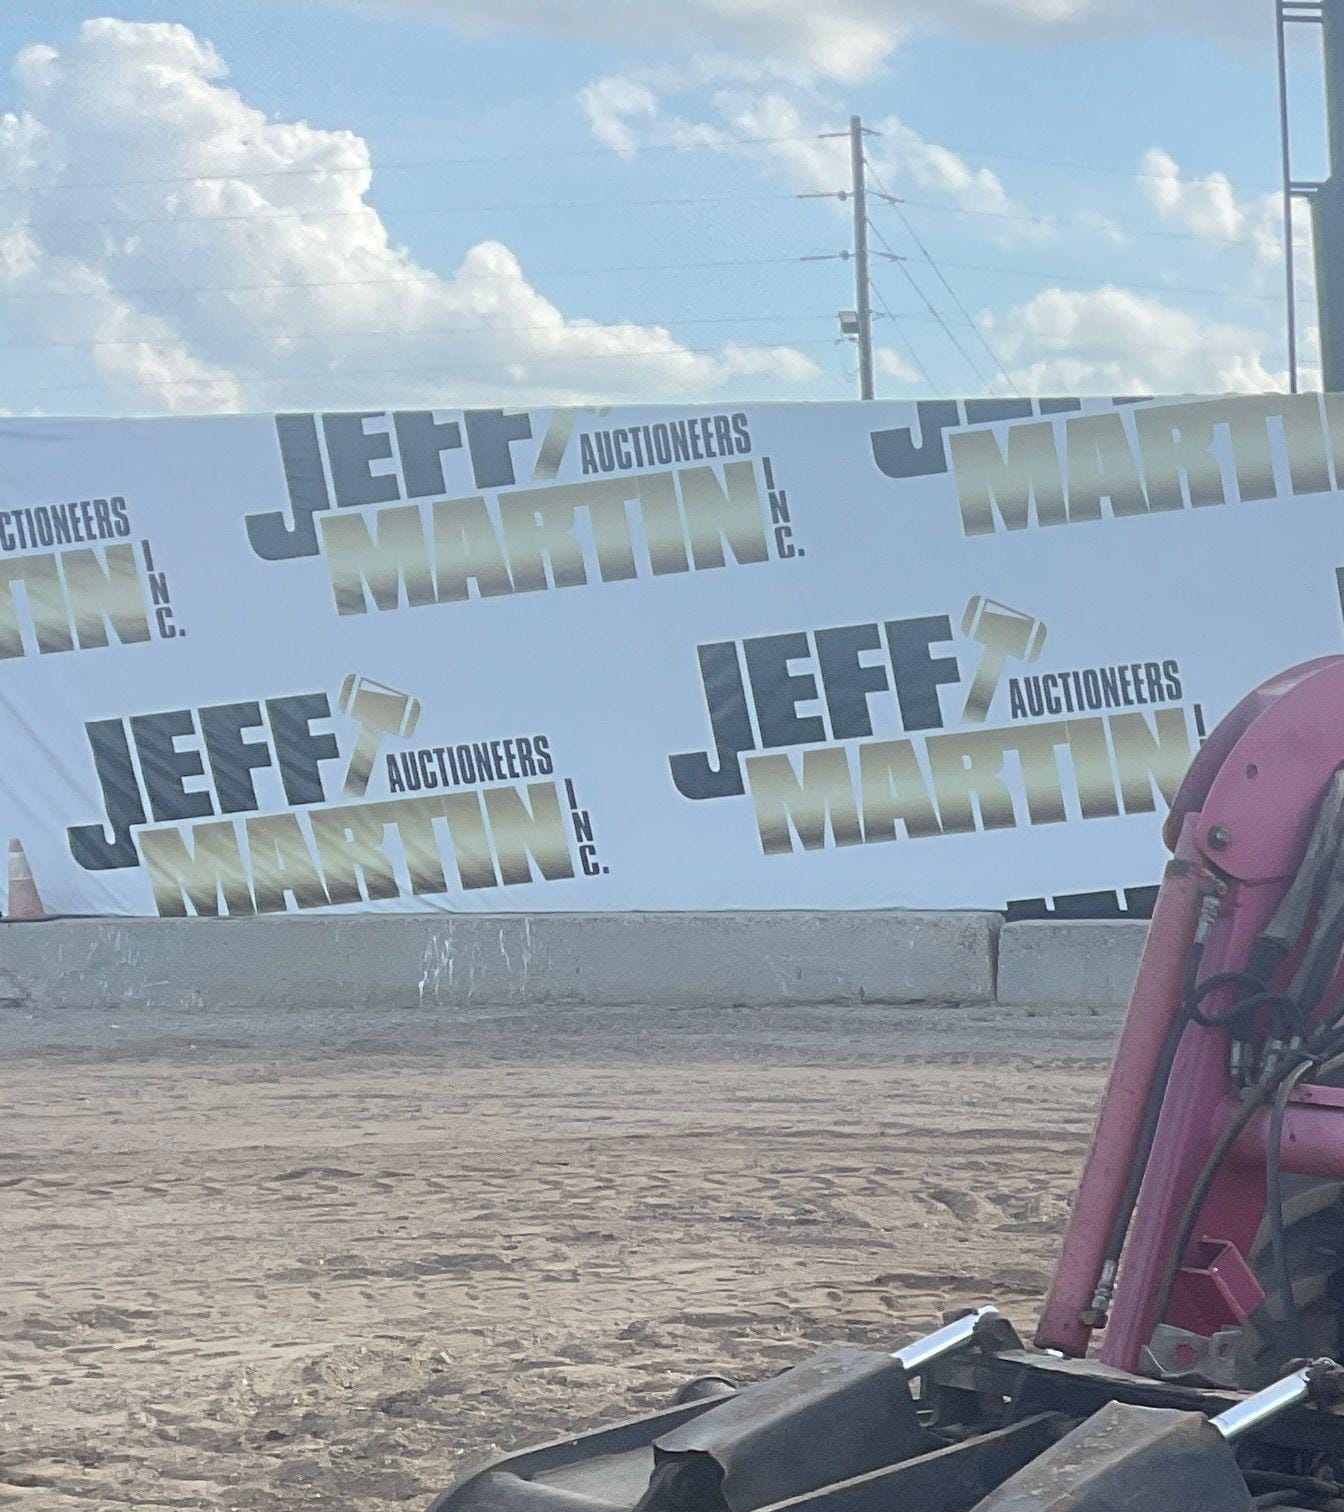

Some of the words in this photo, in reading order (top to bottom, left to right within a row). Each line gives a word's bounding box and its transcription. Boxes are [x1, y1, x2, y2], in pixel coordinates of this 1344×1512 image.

[245, 409, 532, 561] JEFF
[580, 412, 752, 475] AUCTIONEERS
[0, 496, 131, 552] CTIONEERS
[320, 460, 769, 616] MARTIN
[669, 614, 961, 800] JEFF
[1009, 660, 1182, 719] AUCTIONEERS
[67, 692, 340, 871] JEFF
[386, 736, 554, 793] AUCTIONEERS
[745, 707, 1191, 855] MARTIN
[137, 781, 575, 917] MARTIN
